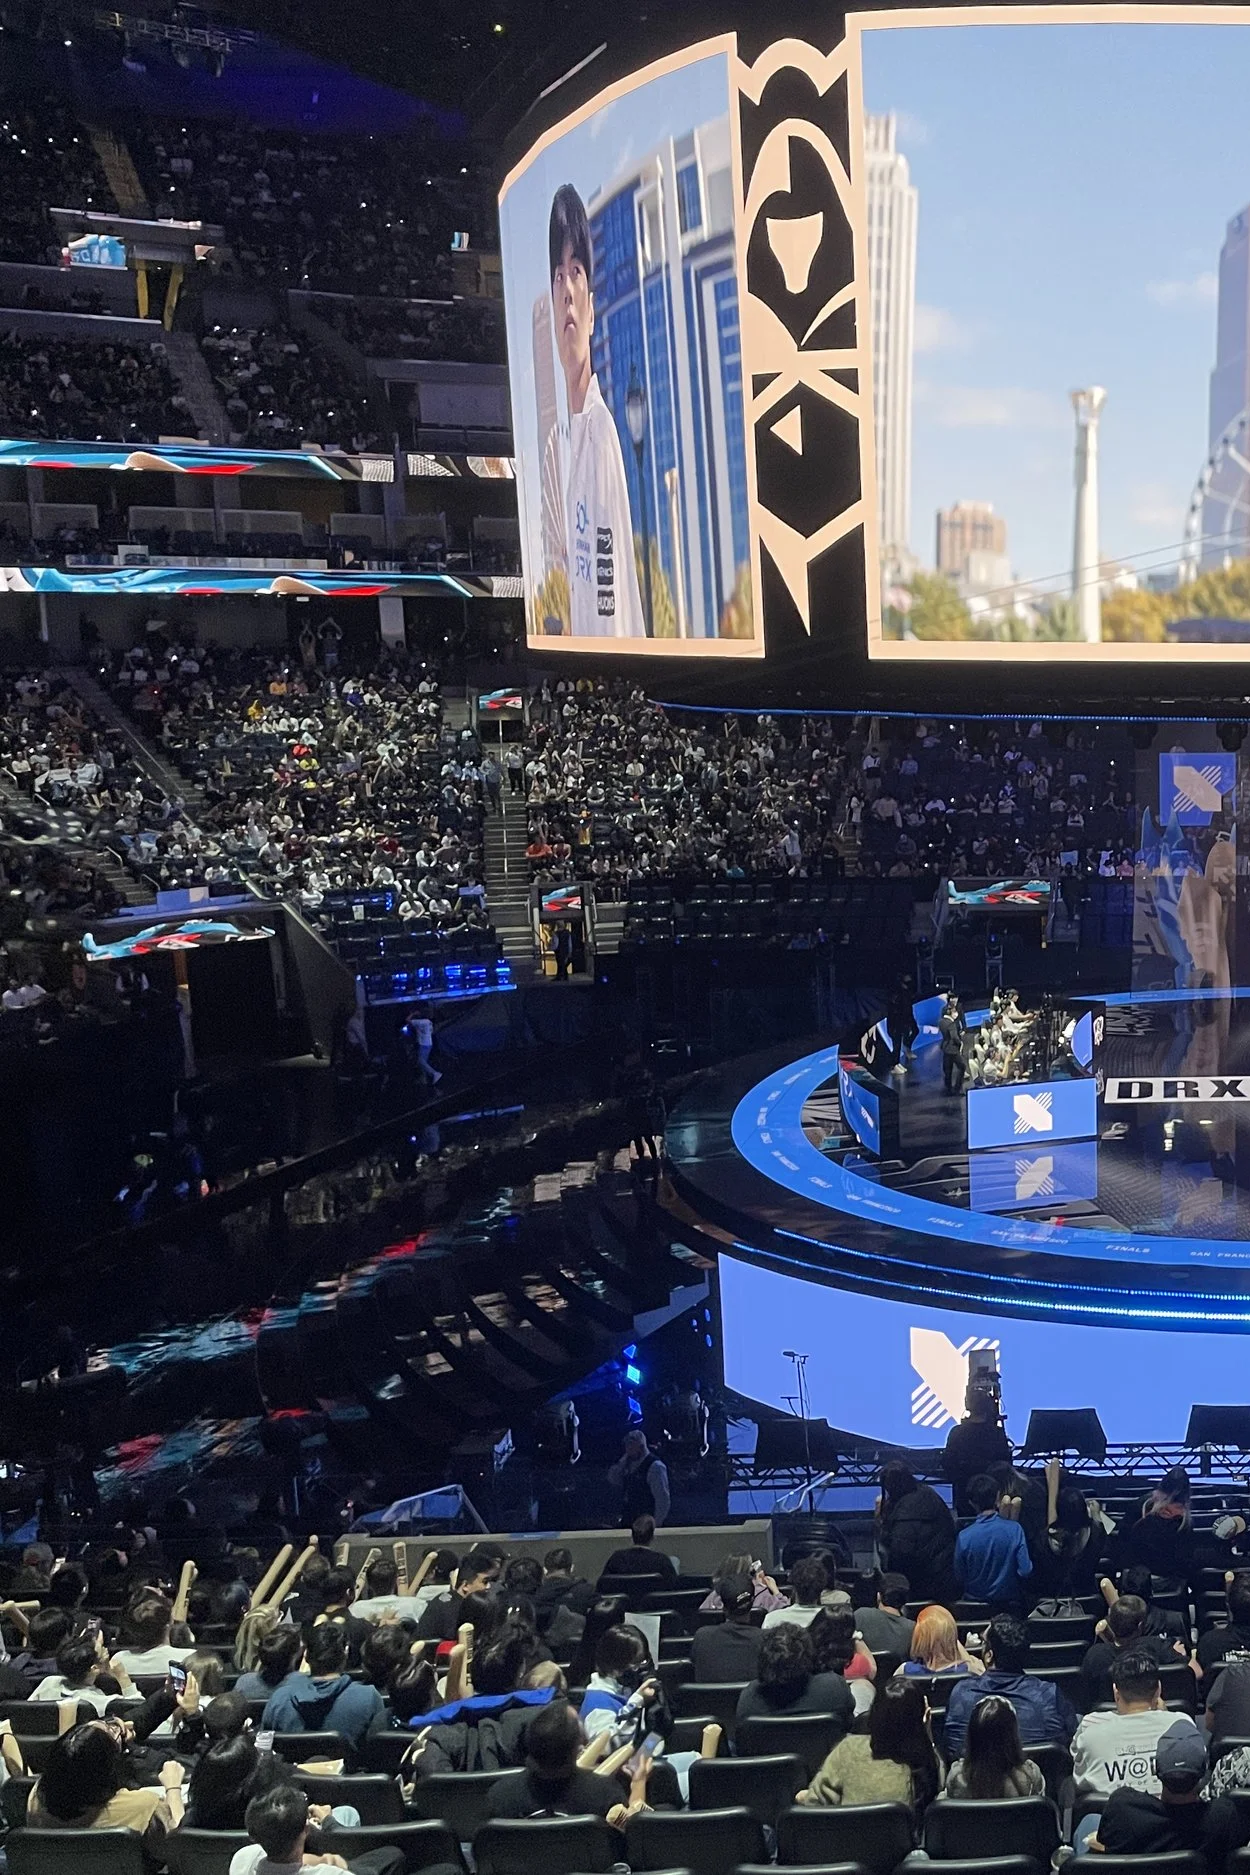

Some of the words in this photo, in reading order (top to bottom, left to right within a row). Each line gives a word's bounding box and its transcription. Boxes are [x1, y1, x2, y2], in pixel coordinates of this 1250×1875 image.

[1117, 1079, 1247, 1099] DRX
[1105, 1243, 1151, 1254] FINALS
[1190, 1250, 1211, 1258] SAN
